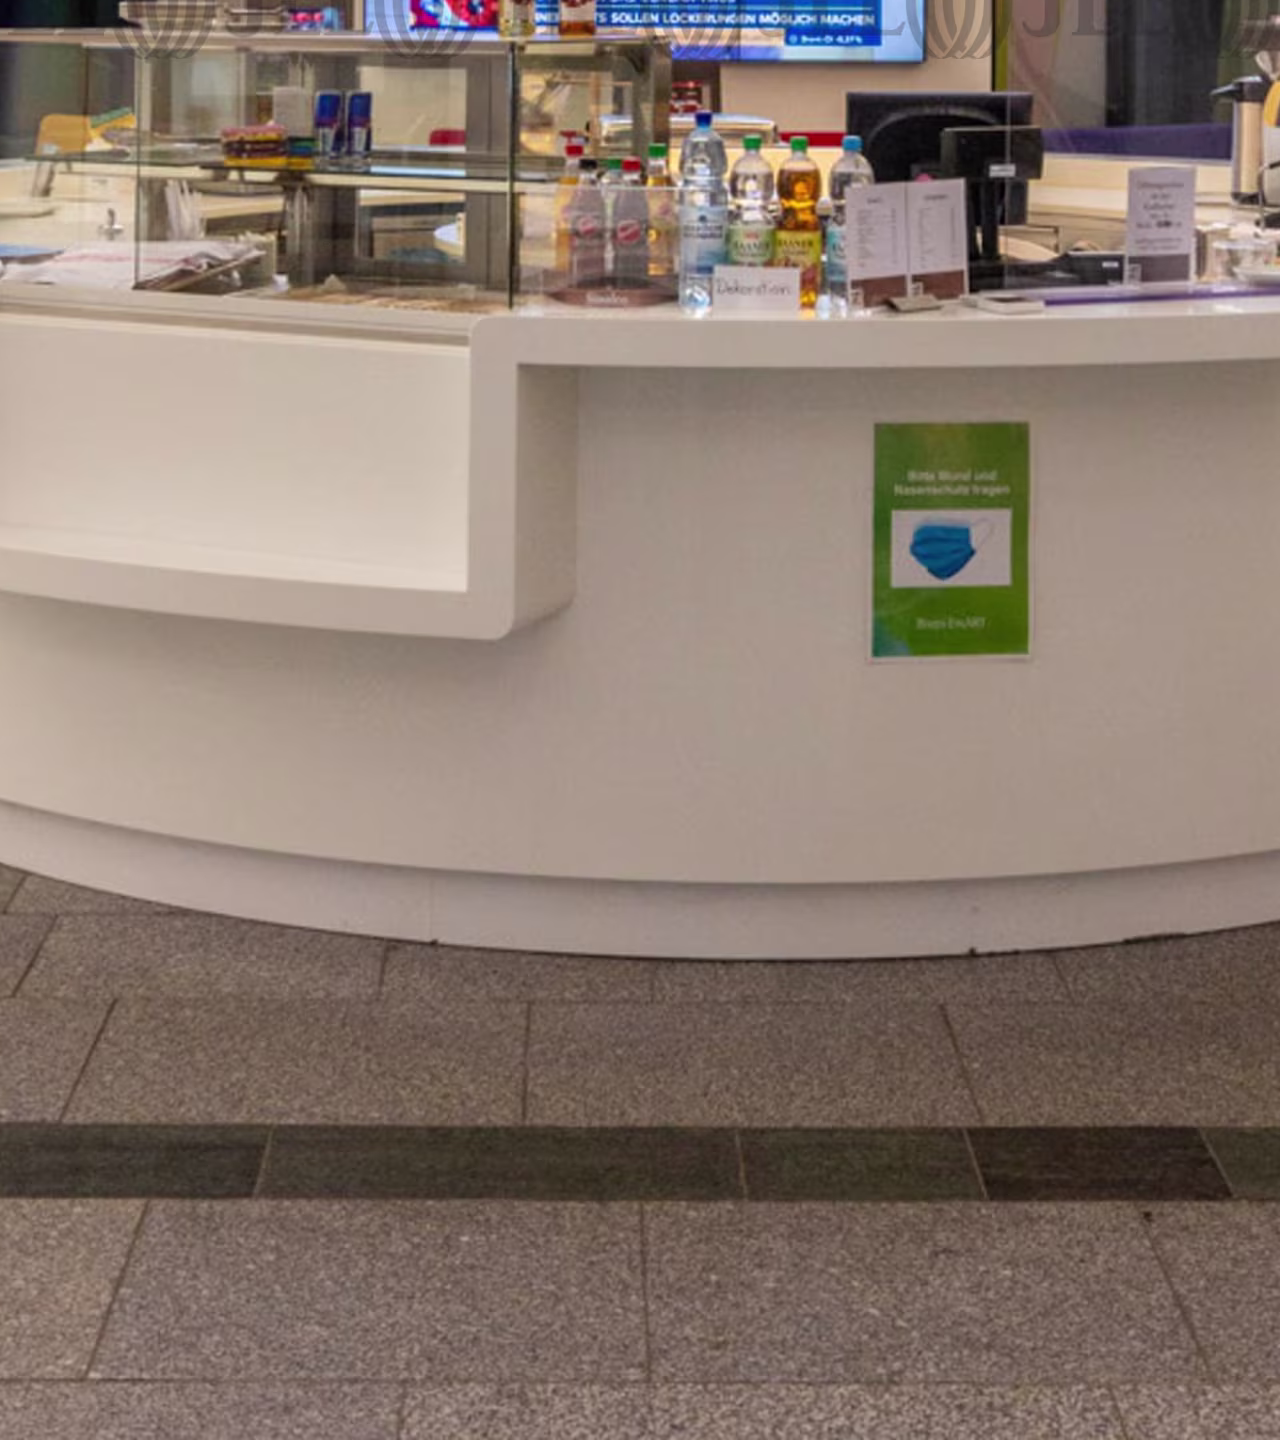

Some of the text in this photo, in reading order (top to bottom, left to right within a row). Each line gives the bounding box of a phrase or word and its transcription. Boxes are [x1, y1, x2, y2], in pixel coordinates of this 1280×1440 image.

[610, 12, 660, 24] SOLLEN
[662, 12, 757, 25] LOCKERUNGEN
[758, 11, 817, 26] MÖGLICH
[820, 13, 876, 26] MACHEN
[716, 276, 791, 296] Dekoration
